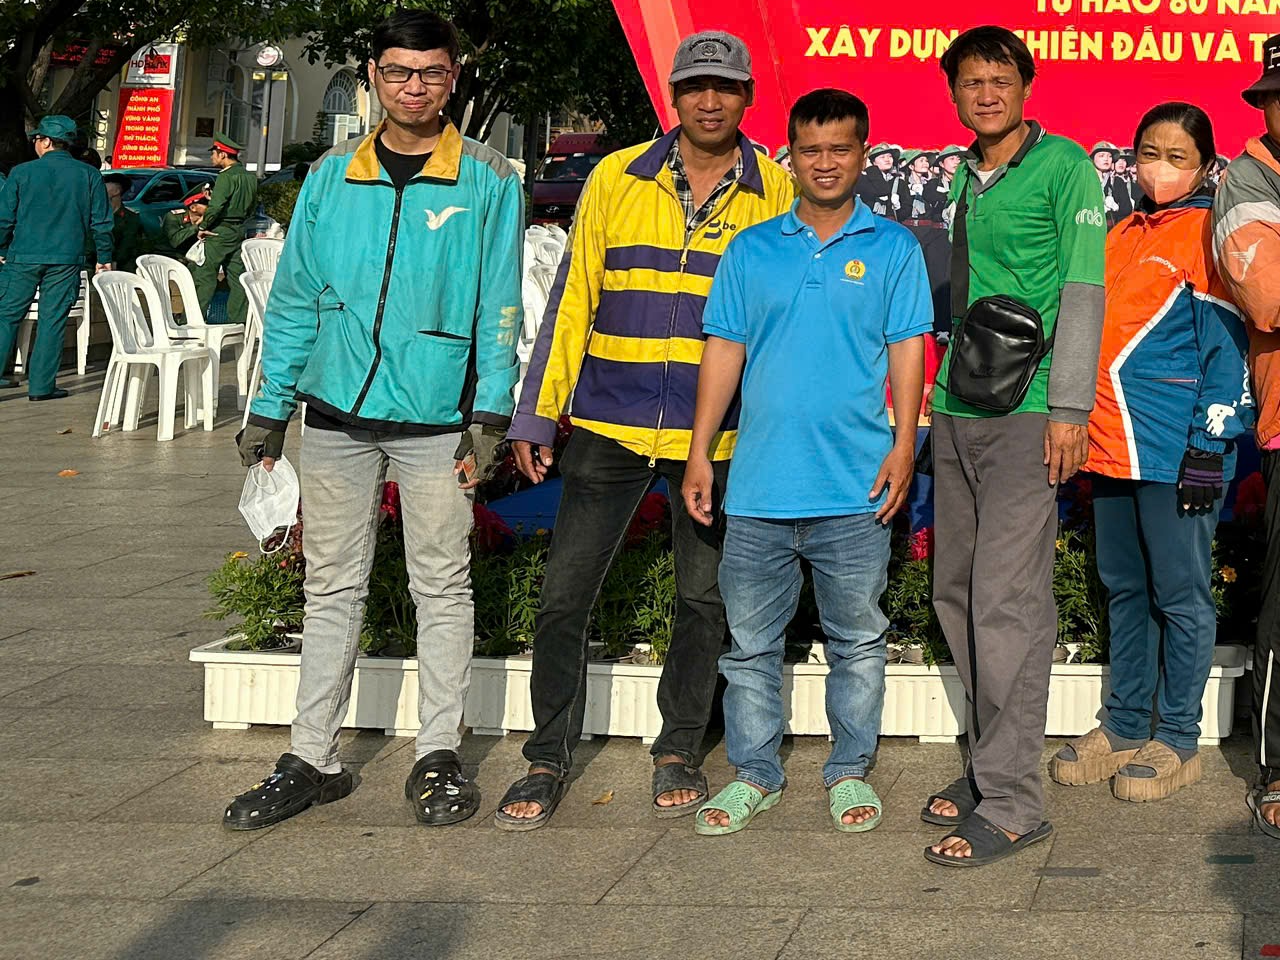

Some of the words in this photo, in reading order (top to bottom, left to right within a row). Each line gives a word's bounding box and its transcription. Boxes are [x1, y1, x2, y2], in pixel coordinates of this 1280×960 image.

[804, 24, 881, 58] XÂY
[889, 28, 960, 62] DỰN
[1012, 24, 1103, 61] HIẾN
[1111, 25, 1183, 62] ĐẤU
[1191, 29, 1242, 62] VÀ
[722, 221, 737, 231] be
